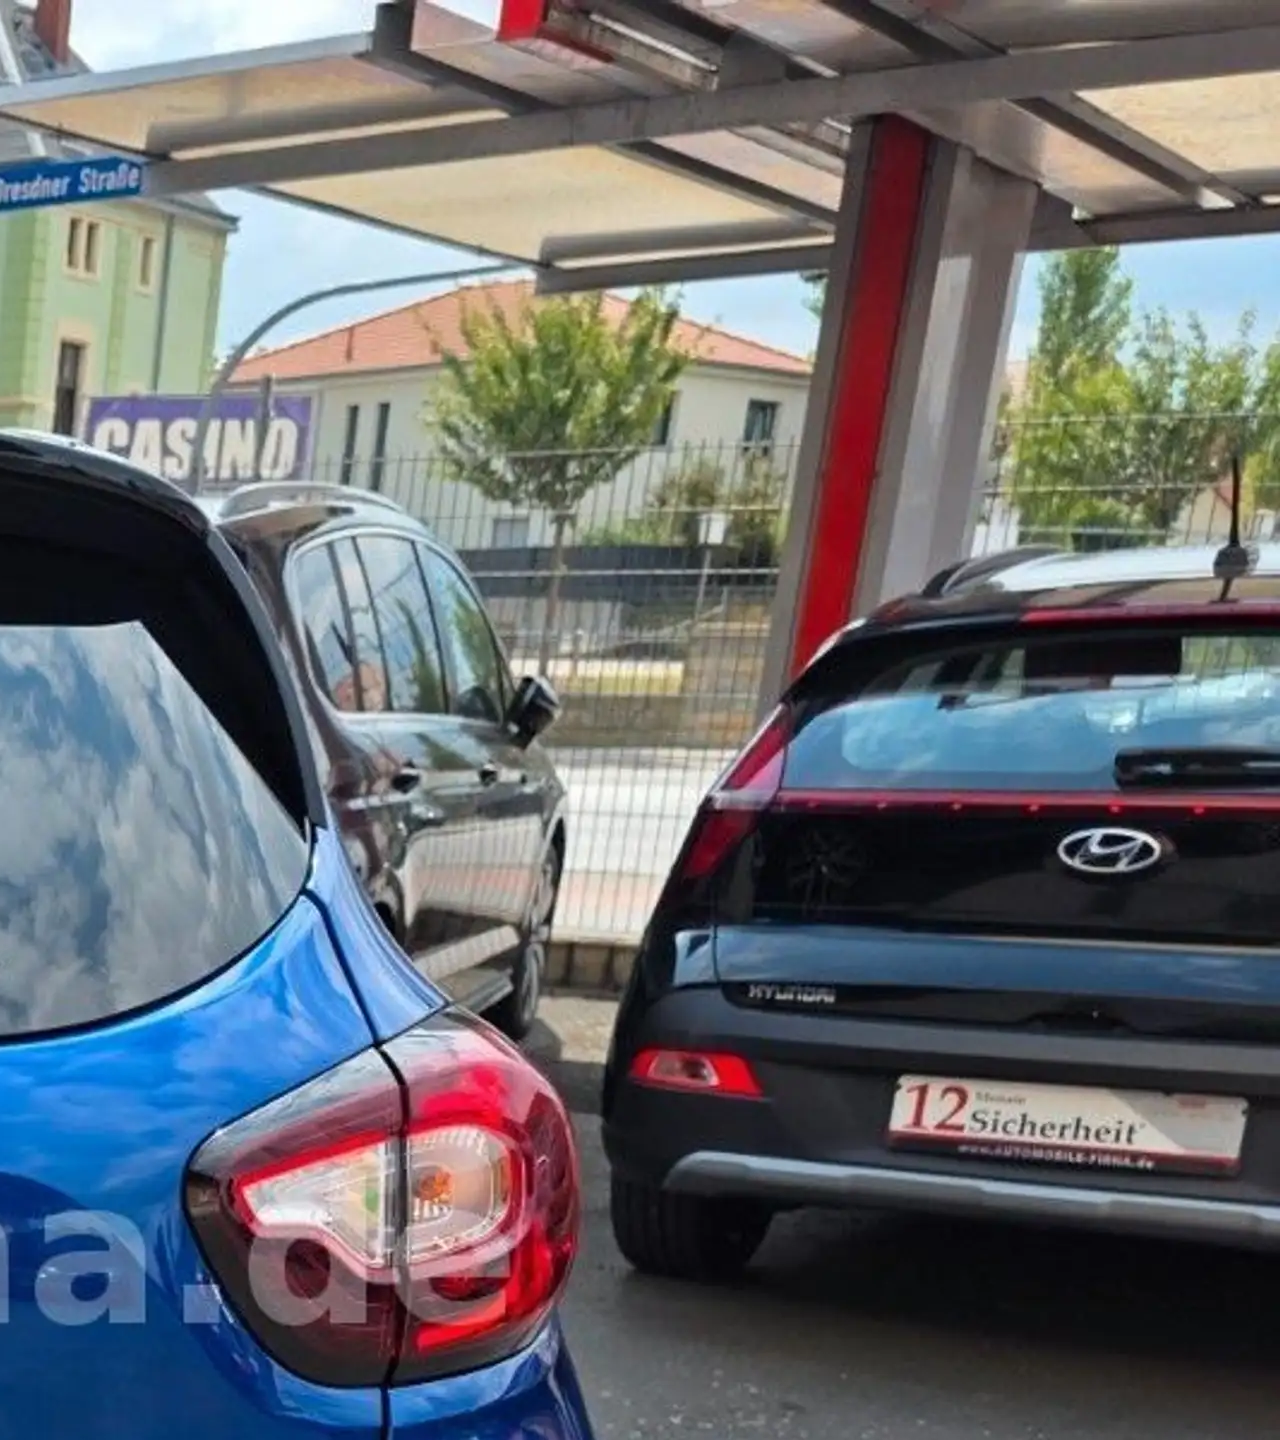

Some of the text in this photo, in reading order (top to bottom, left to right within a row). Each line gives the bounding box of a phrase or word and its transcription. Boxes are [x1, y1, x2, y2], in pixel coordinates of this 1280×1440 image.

[78, 162, 139, 194] Straße
[93, 416, 299, 480] CASINO
[748, 983, 837, 1004] HYUNDAI
[905, 1081, 969, 1133] 12
